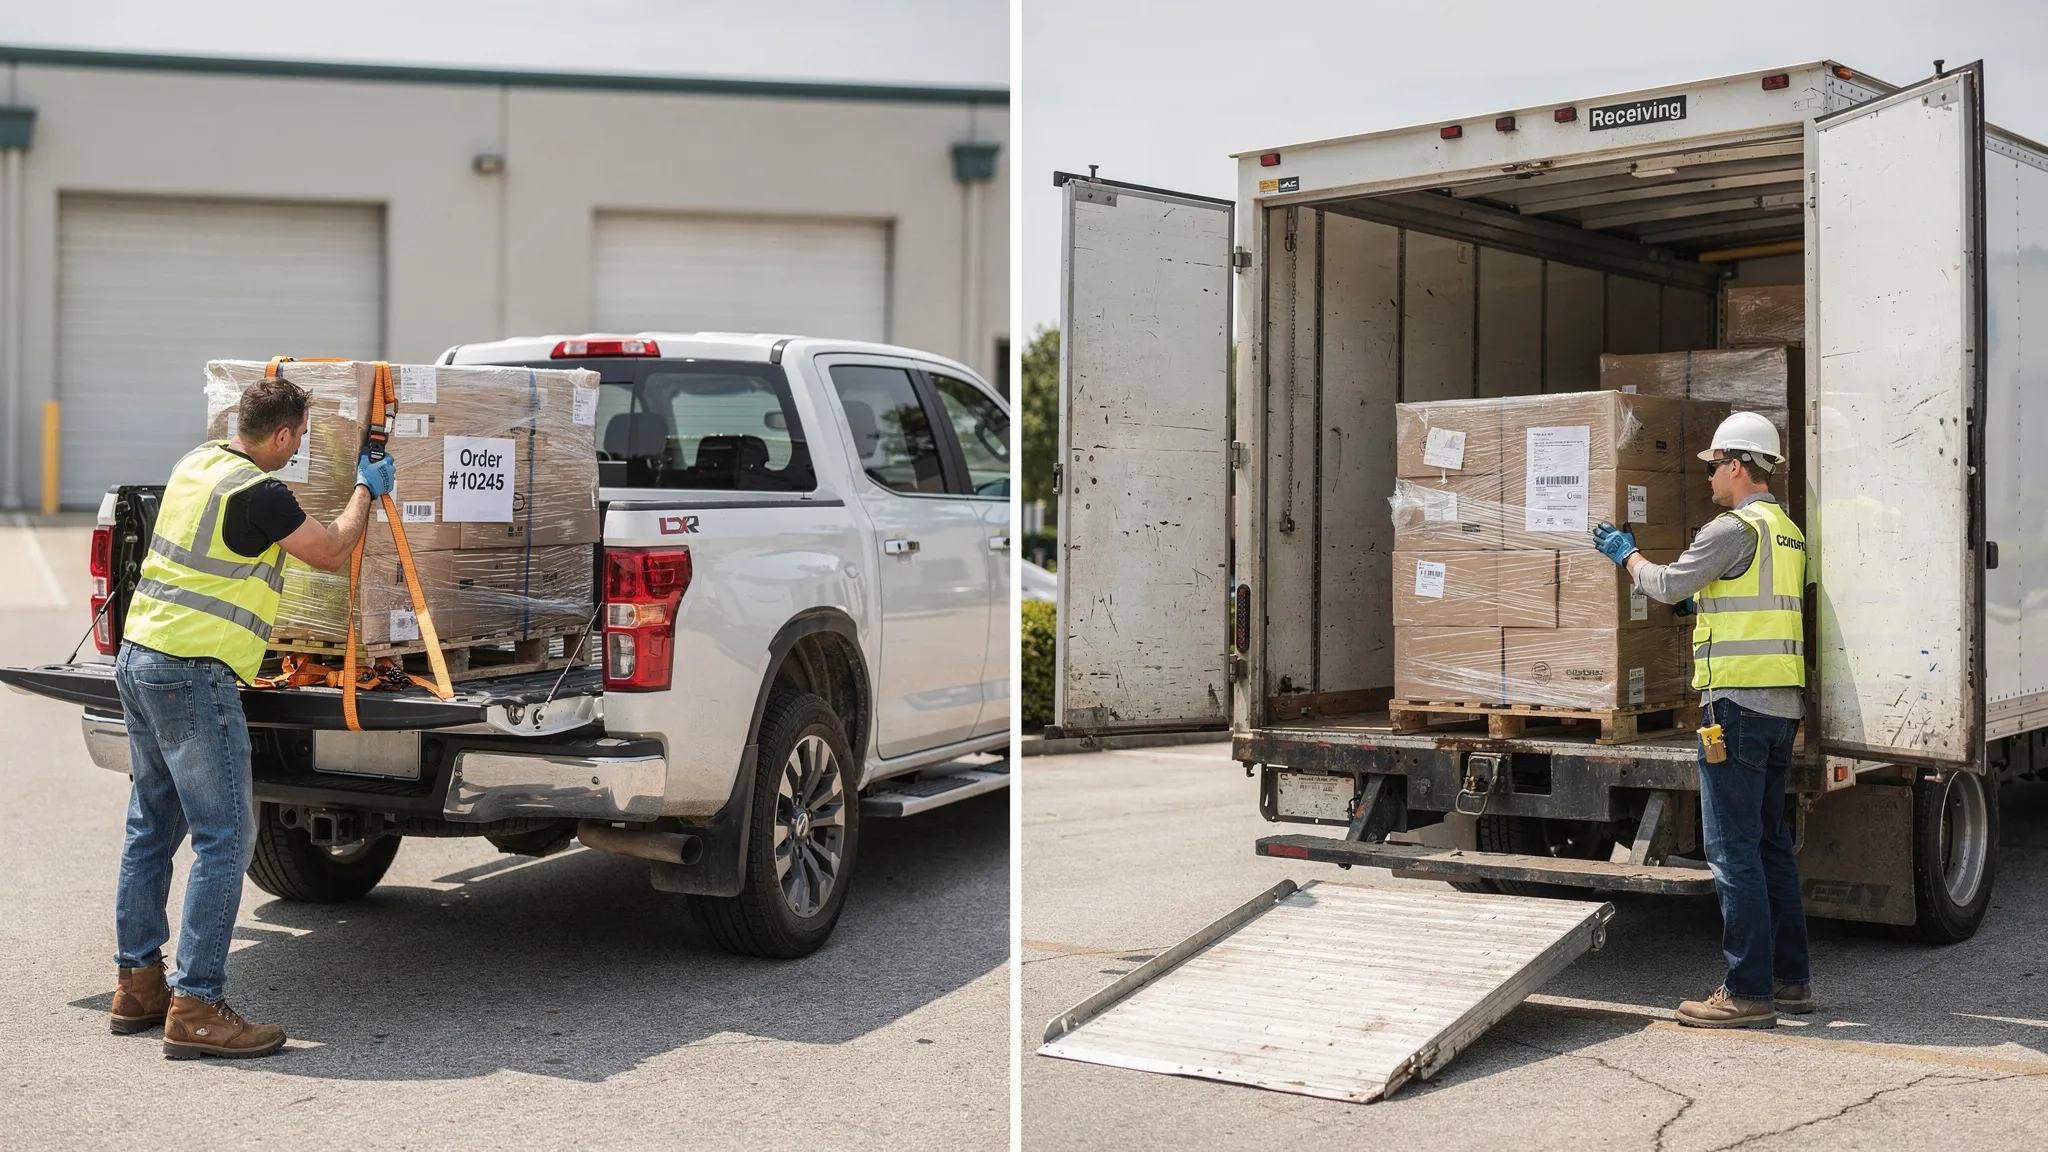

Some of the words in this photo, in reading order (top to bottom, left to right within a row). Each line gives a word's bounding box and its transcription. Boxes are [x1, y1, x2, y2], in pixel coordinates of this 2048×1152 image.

[1592, 102, 1681, 127] Receiving
[460, 448, 503, 468] Order
[448, 471, 505, 491] #10245
